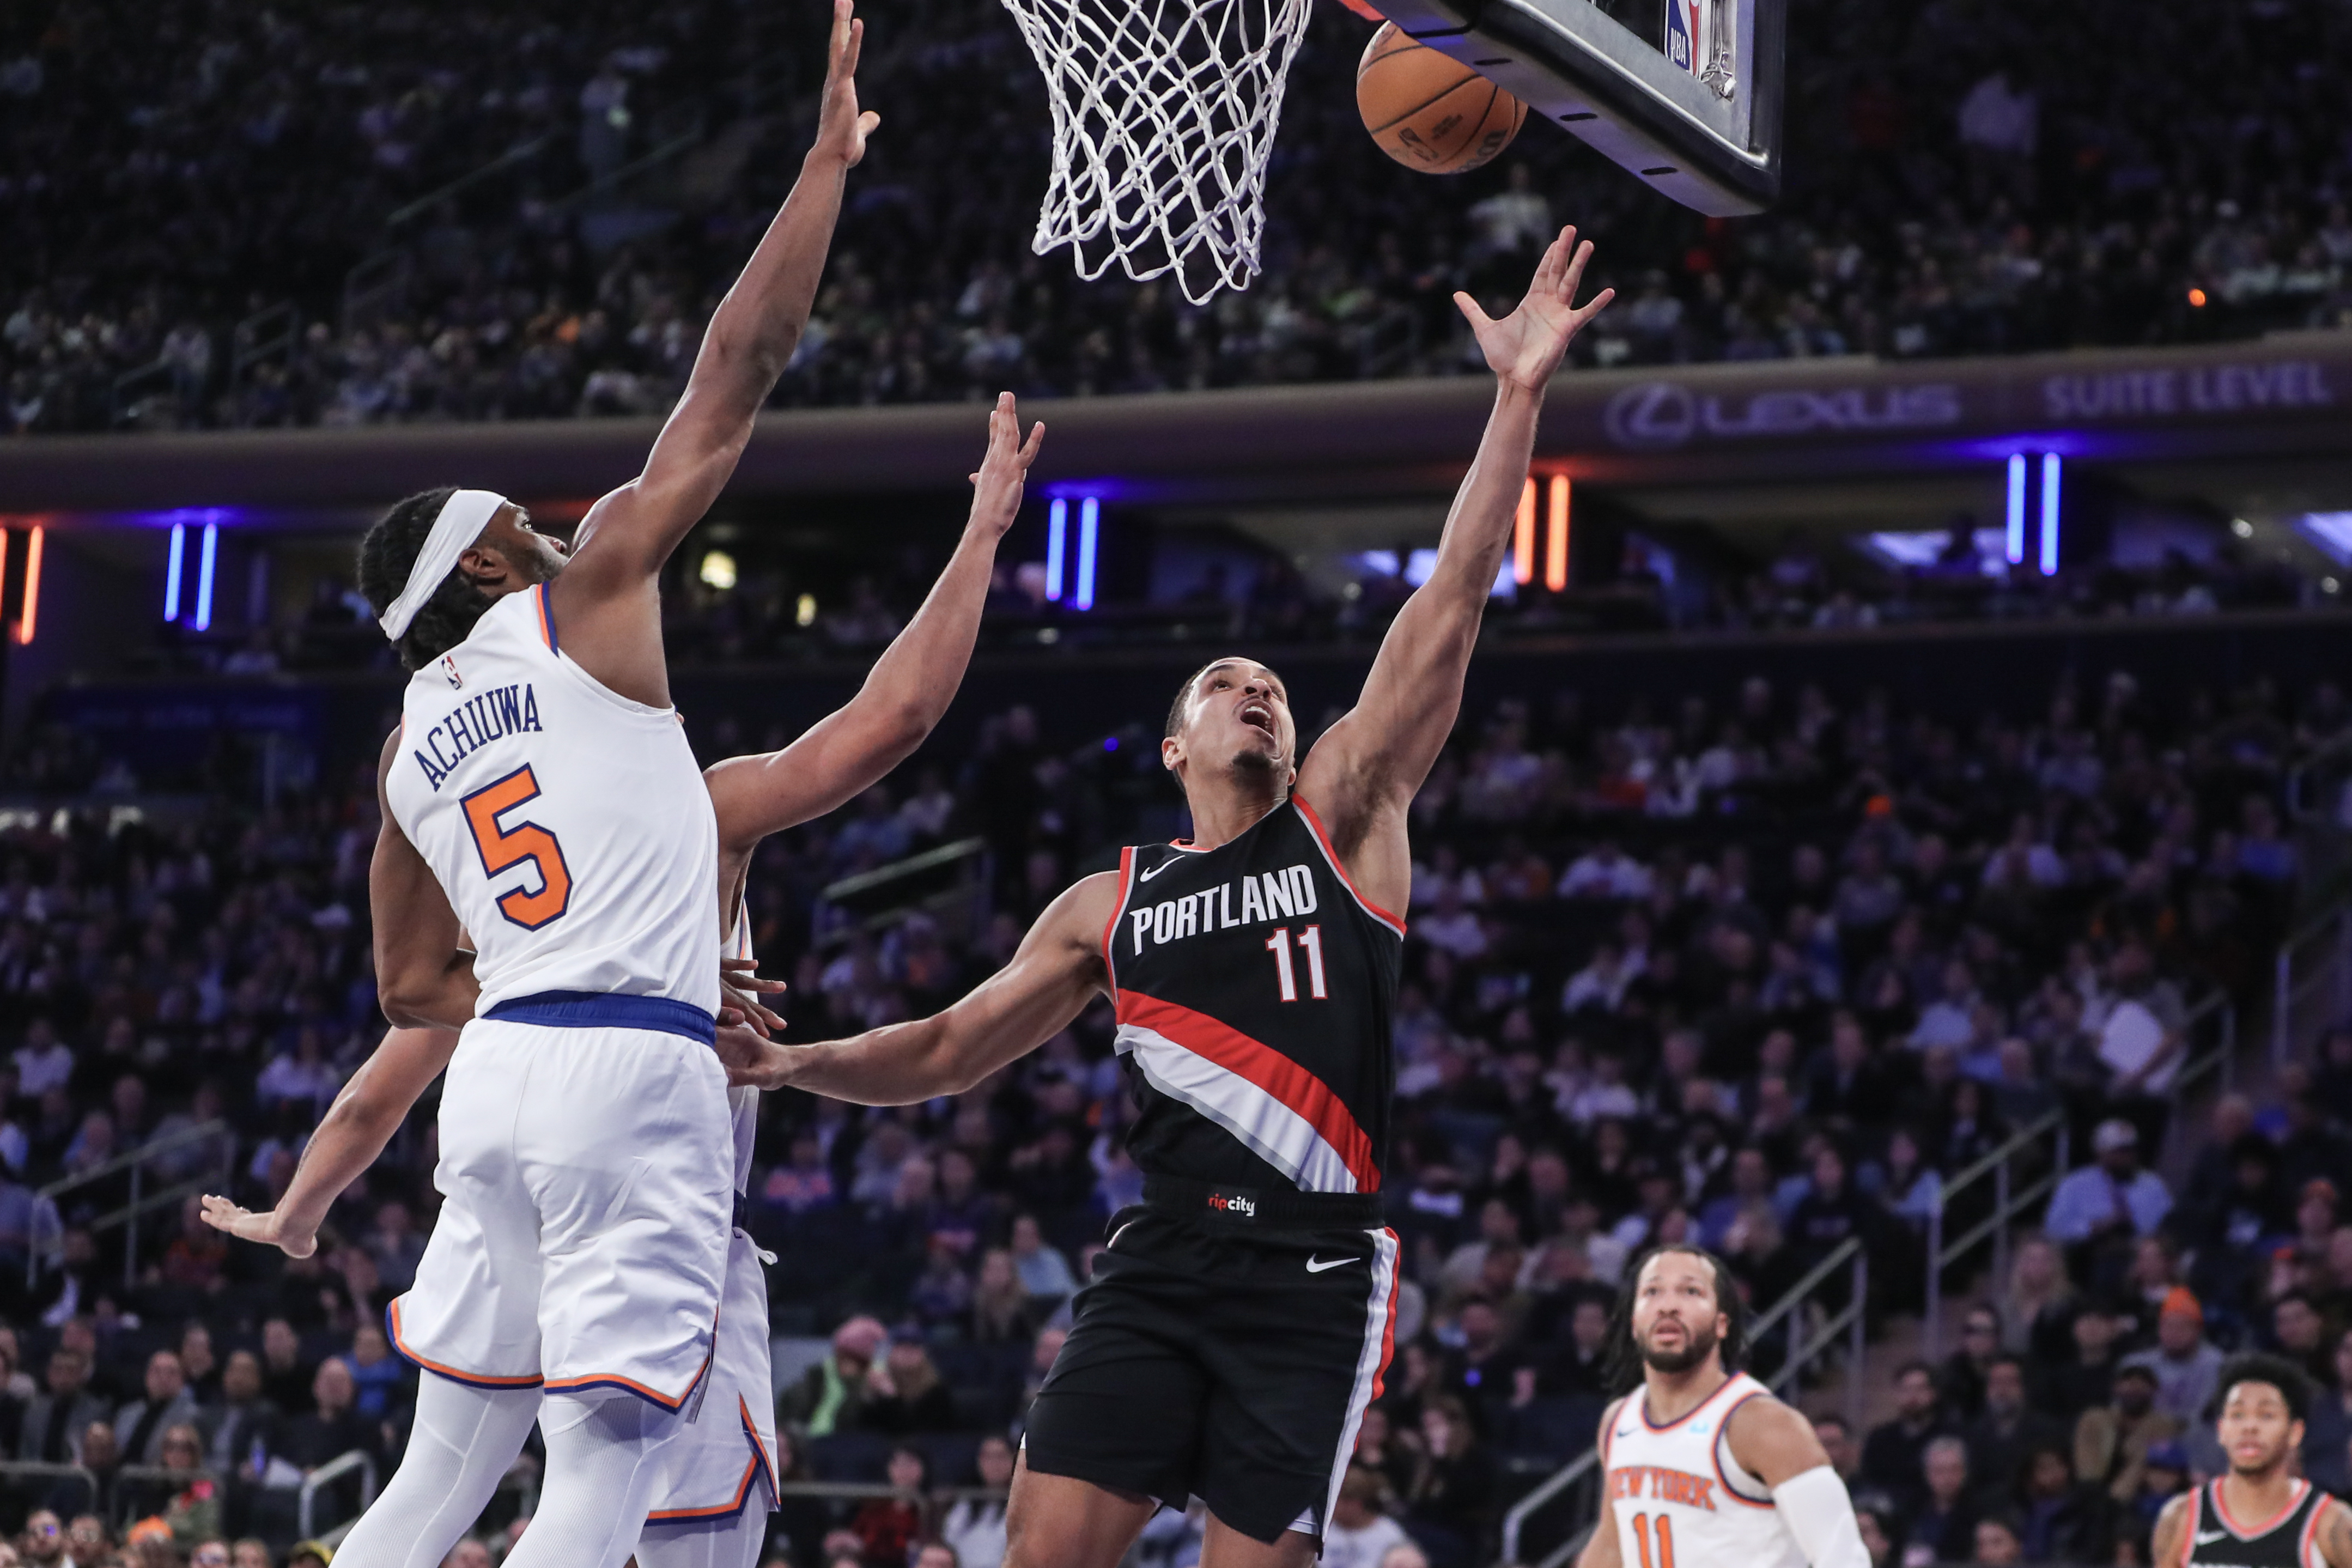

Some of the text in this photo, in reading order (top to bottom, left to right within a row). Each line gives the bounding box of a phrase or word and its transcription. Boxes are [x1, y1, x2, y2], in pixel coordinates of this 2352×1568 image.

[1670, 27, 1686, 65] NBA
[1704, 383, 1961, 435] LEXUS
[2045, 361, 2333, 421] SUITE LEVEL
[414, 683, 543, 792] ACHIUWA
[459, 762, 573, 932] 5
[1129, 864, 1318, 956] PORTLAND
[1265, 924, 1328, 1002] 11
[1649, 1466, 1716, 1511] YORK
[1632, 1512, 1675, 1568] 11
